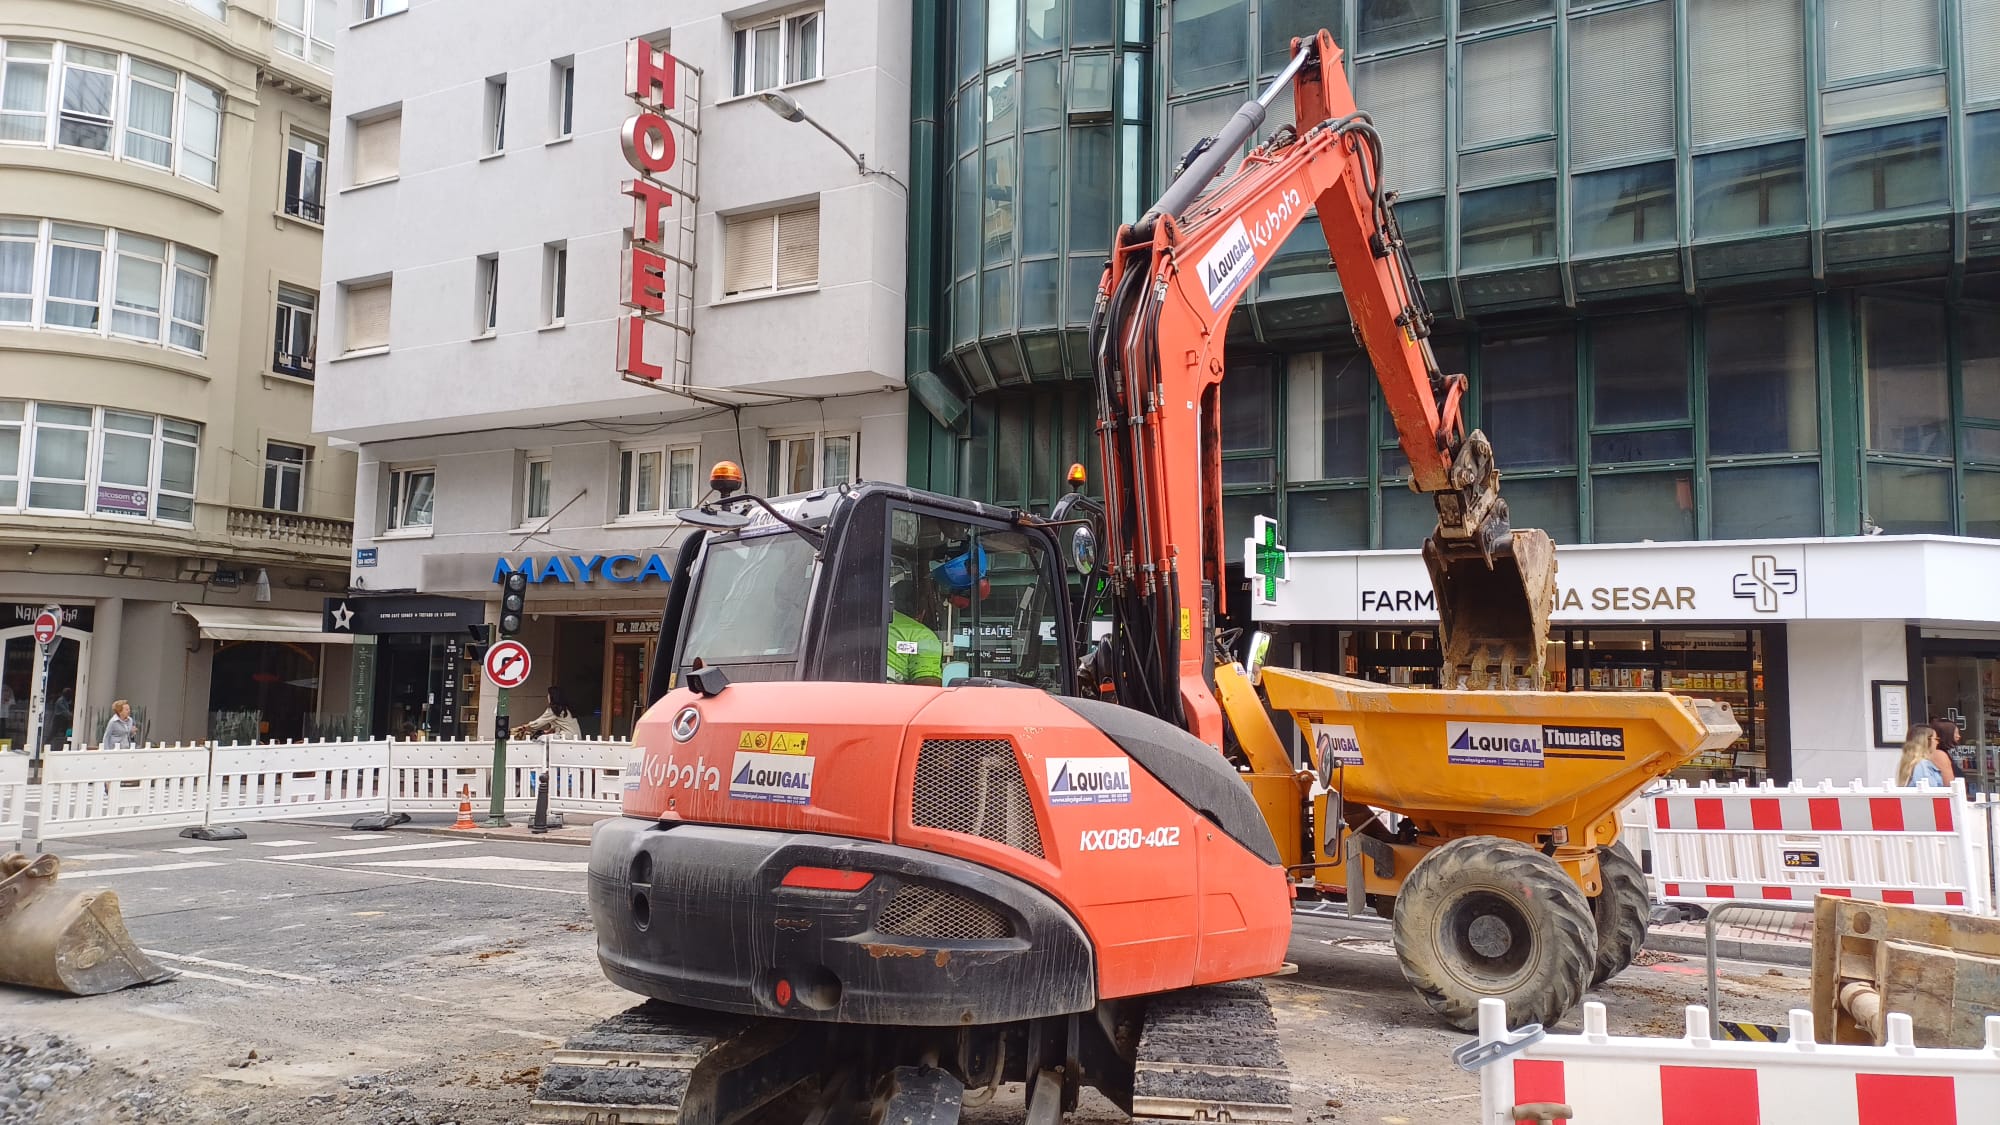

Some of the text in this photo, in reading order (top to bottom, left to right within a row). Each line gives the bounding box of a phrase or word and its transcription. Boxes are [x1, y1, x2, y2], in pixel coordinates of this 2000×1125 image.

[622, 38, 676, 381] HOTEL
[1249, 188, 1301, 248] Kubota
[1362, 589, 1440, 611] FARM
[1554, 586, 1696, 611] IA SESAR
[15, 604, 43, 621] NAN
[1544, 728, 1622, 748] Thwaites
[643, 753, 721, 792] Kubota
